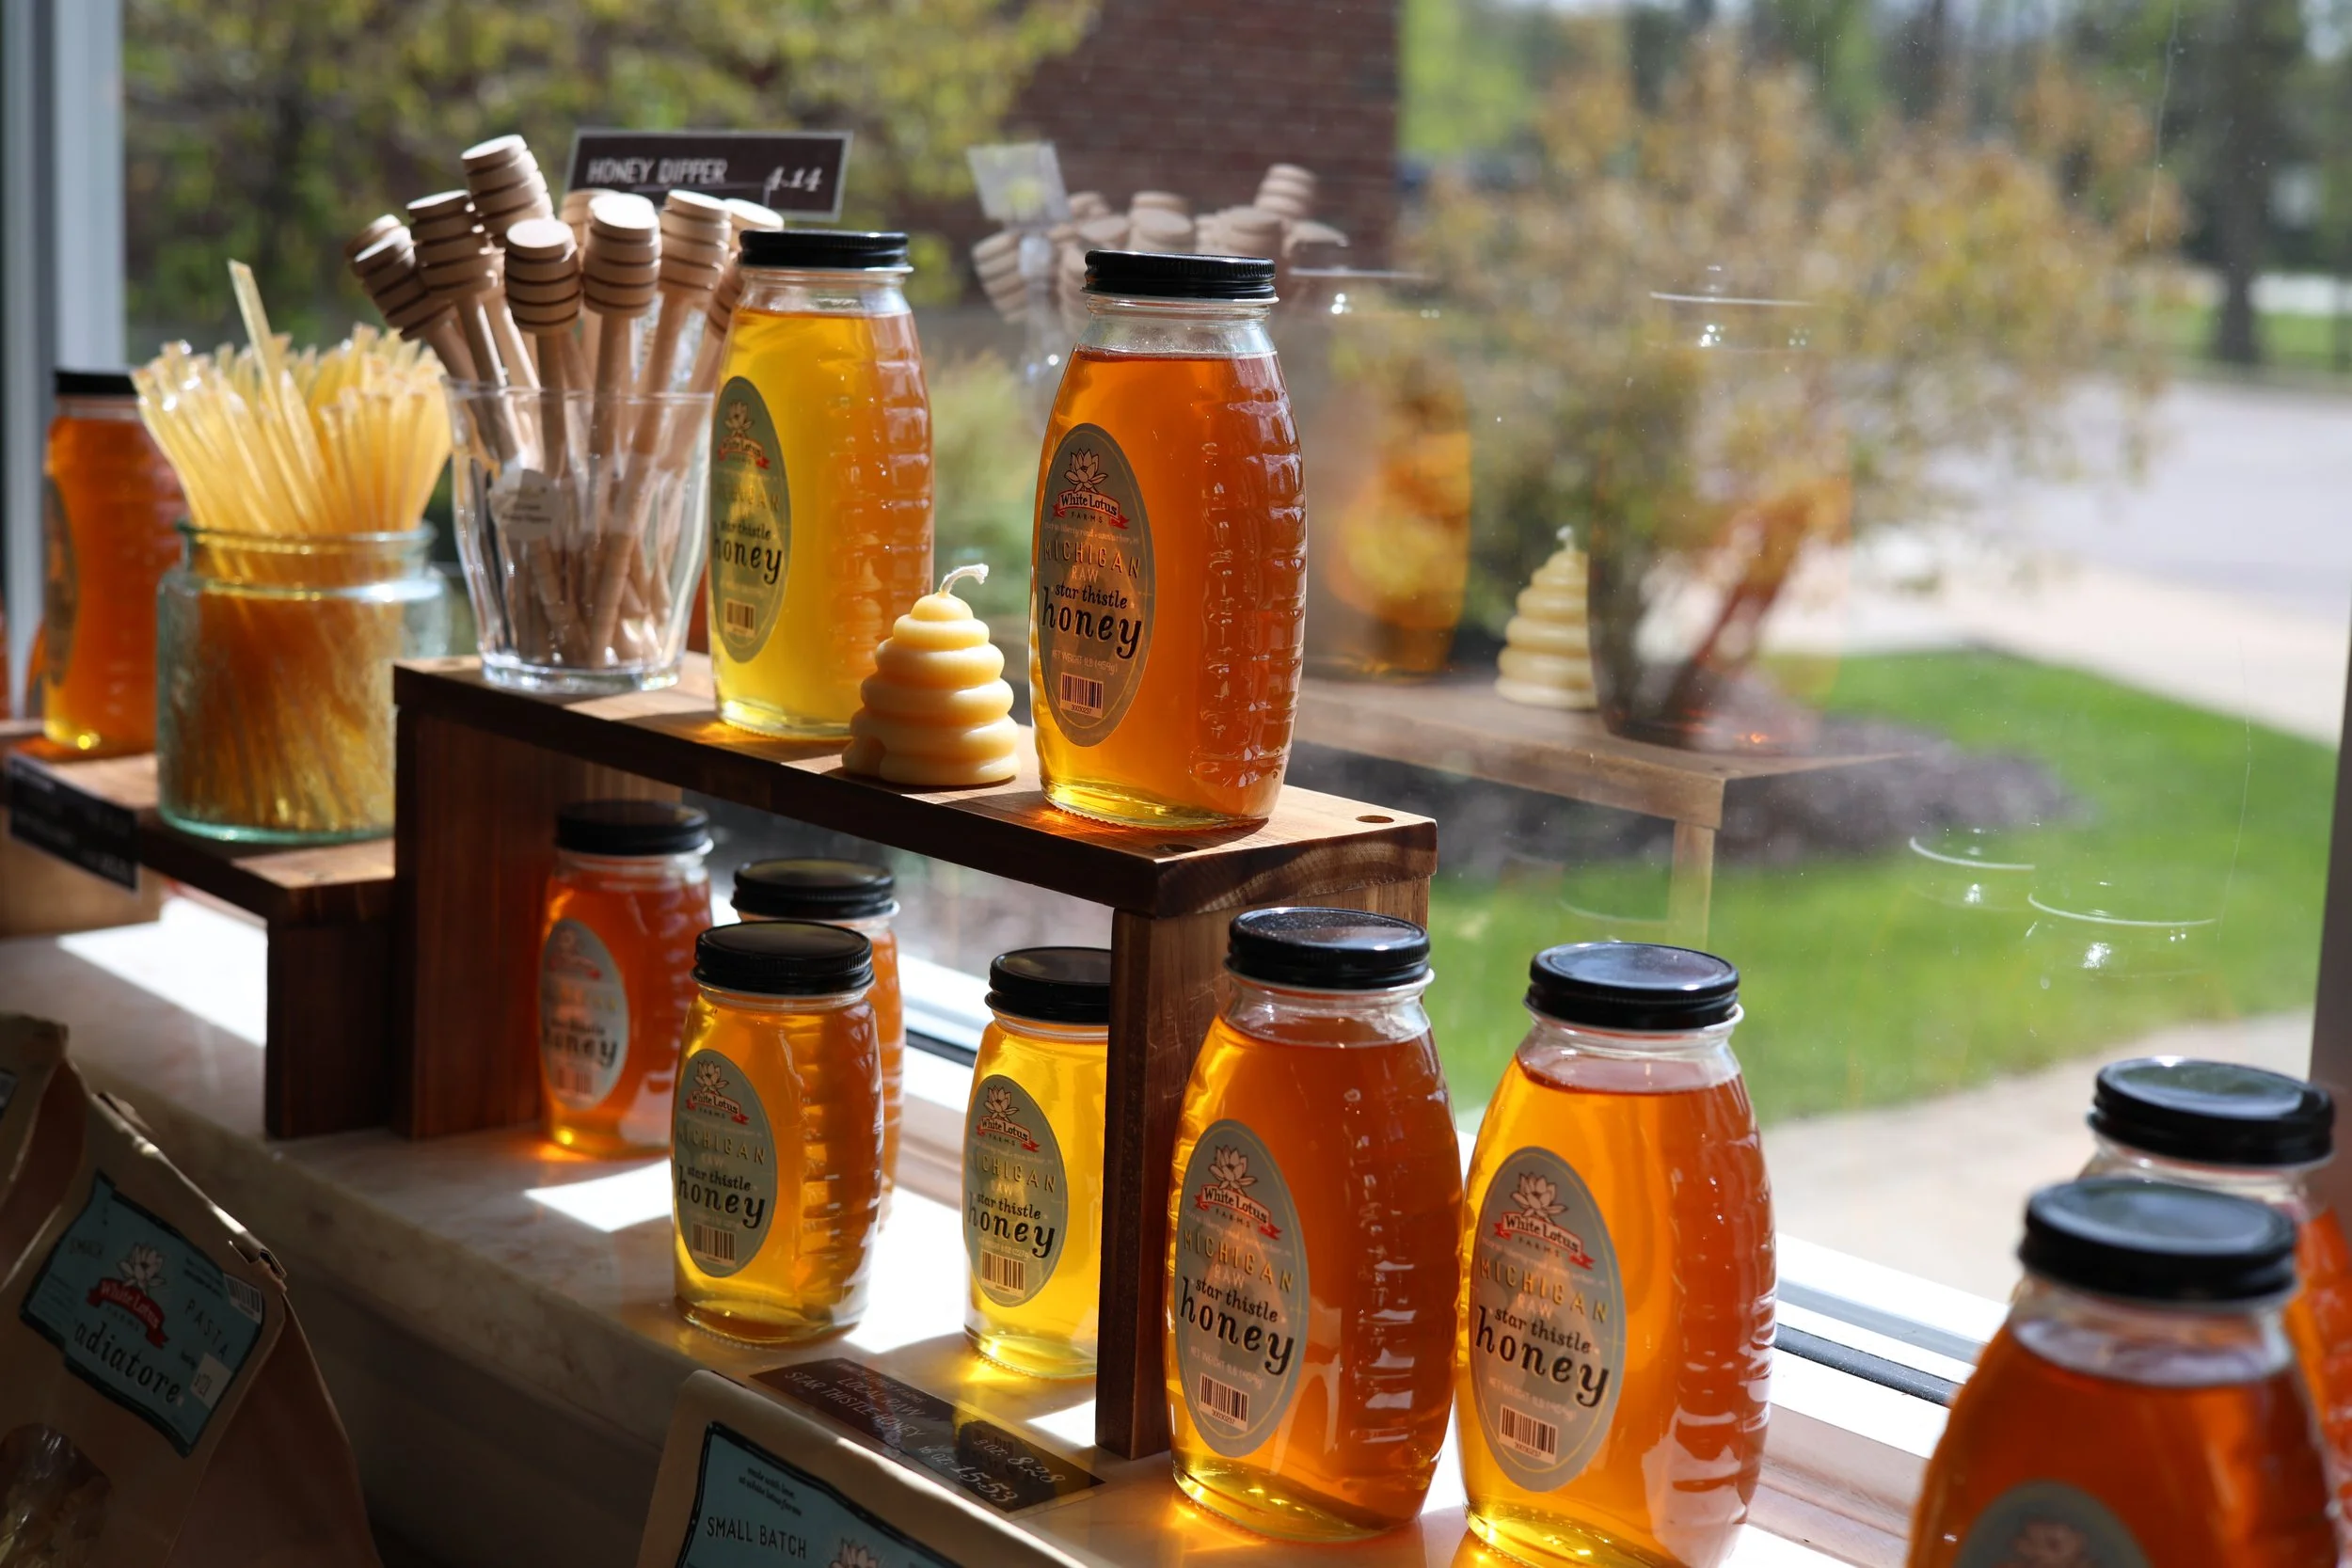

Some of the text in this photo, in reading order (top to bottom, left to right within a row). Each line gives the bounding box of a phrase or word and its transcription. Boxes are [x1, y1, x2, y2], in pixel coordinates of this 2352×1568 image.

[586, 157, 655, 184] HONEY
[657, 157, 728, 184] DIPPER
[1060, 492, 1118, 516] White Lotus
[1071, 511, 1104, 524] FARMS
[1043, 539, 1140, 578] MICHIGAN
[1072, 566, 1099, 583] RAW
[1055, 581, 1128, 610] star thistle
[1041, 586, 1142, 659] honey
[691, 1092, 739, 1115] White Lotus
[981, 1117, 1028, 1141] White Lotus
[988, 1132, 1016, 1147] FARMS
[677, 1164, 766, 1229] honey
[687, 1166, 751, 1192] star thistle
[968, 1191, 1056, 1259] honey
[977, 1192, 1041, 1220] star thistle
[1203, 1187, 1267, 1224] White Lotus
[1215, 1208, 1251, 1229] FARMS
[1505, 1214, 1580, 1253] White Lotus
[1518, 1237, 1561, 1259] FARMS
[1183, 1227, 1295, 1293] MICHIGAN
[1214, 1263, 1247, 1289] RAW
[100, 1279, 134, 1307] White
[133, 1298, 161, 1328] Lotus
[1196, 1277, 1279, 1323] star thistle
[1479, 1256, 1608, 1323] MICHIGAN
[1517, 1293, 1552, 1321] RAW
[184, 1298, 228, 1357] PASTA
[1180, 1275, 1295, 1376] honey
[1494, 1307, 1591, 1354] star thistle
[74, 1319, 182, 1404] adiatore
[1475, 1305, 1610, 1408] honey
[785, 1371, 926, 1438] STAR THISTLE HONEY
[837, 1377, 926, 1417] LOCAL RAW
[918, 1446, 934, 1455] 16
[949, 1465, 1019, 1502] 15.53
[1007, 1456, 1066, 1483] 8.28
[707, 1516, 807, 1560] SMALL BATCH
